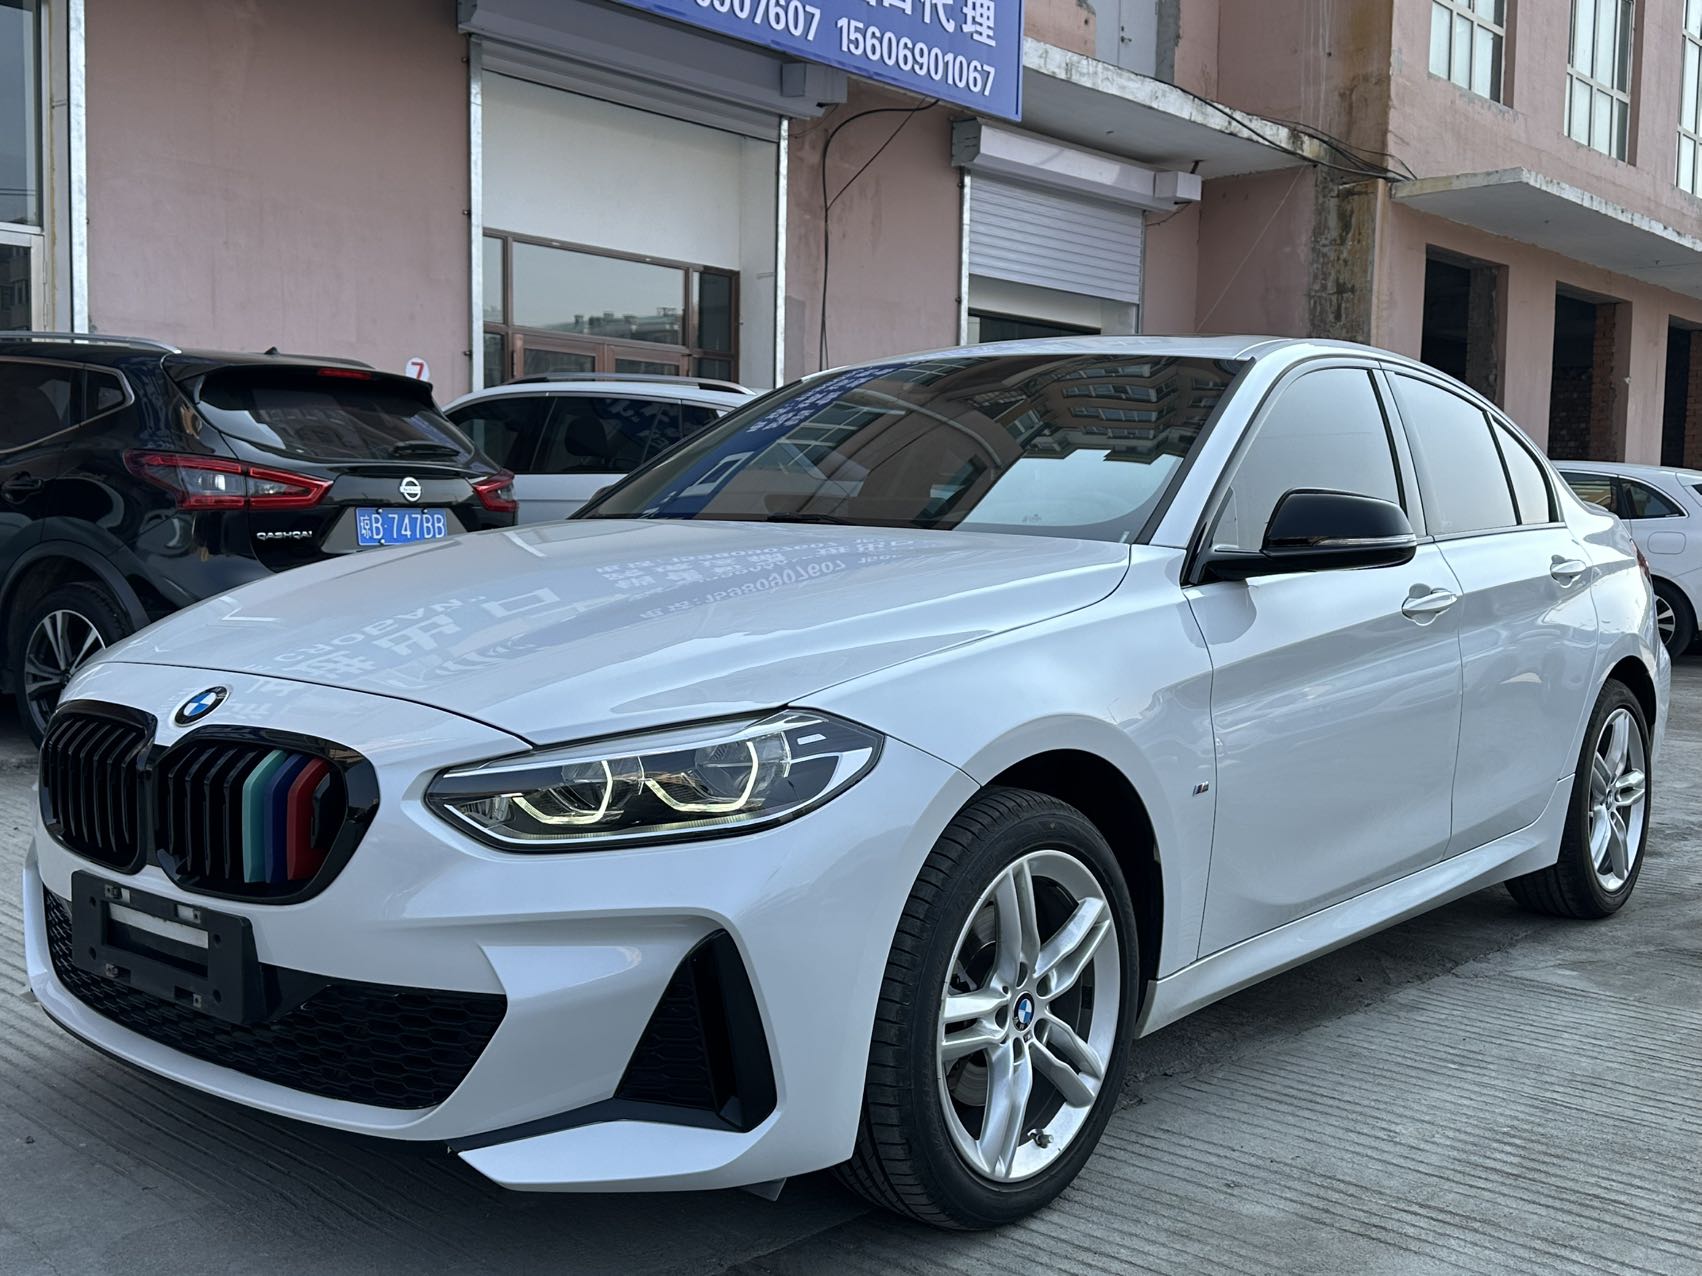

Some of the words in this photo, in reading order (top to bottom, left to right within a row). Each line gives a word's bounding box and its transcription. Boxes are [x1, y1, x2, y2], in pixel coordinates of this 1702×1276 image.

[866, 0, 996, 47] 代理
[836, 17, 996, 96] 15606901067
[411, 361, 425, 380] 7
[256, 530, 313, 541] QASHQAI
